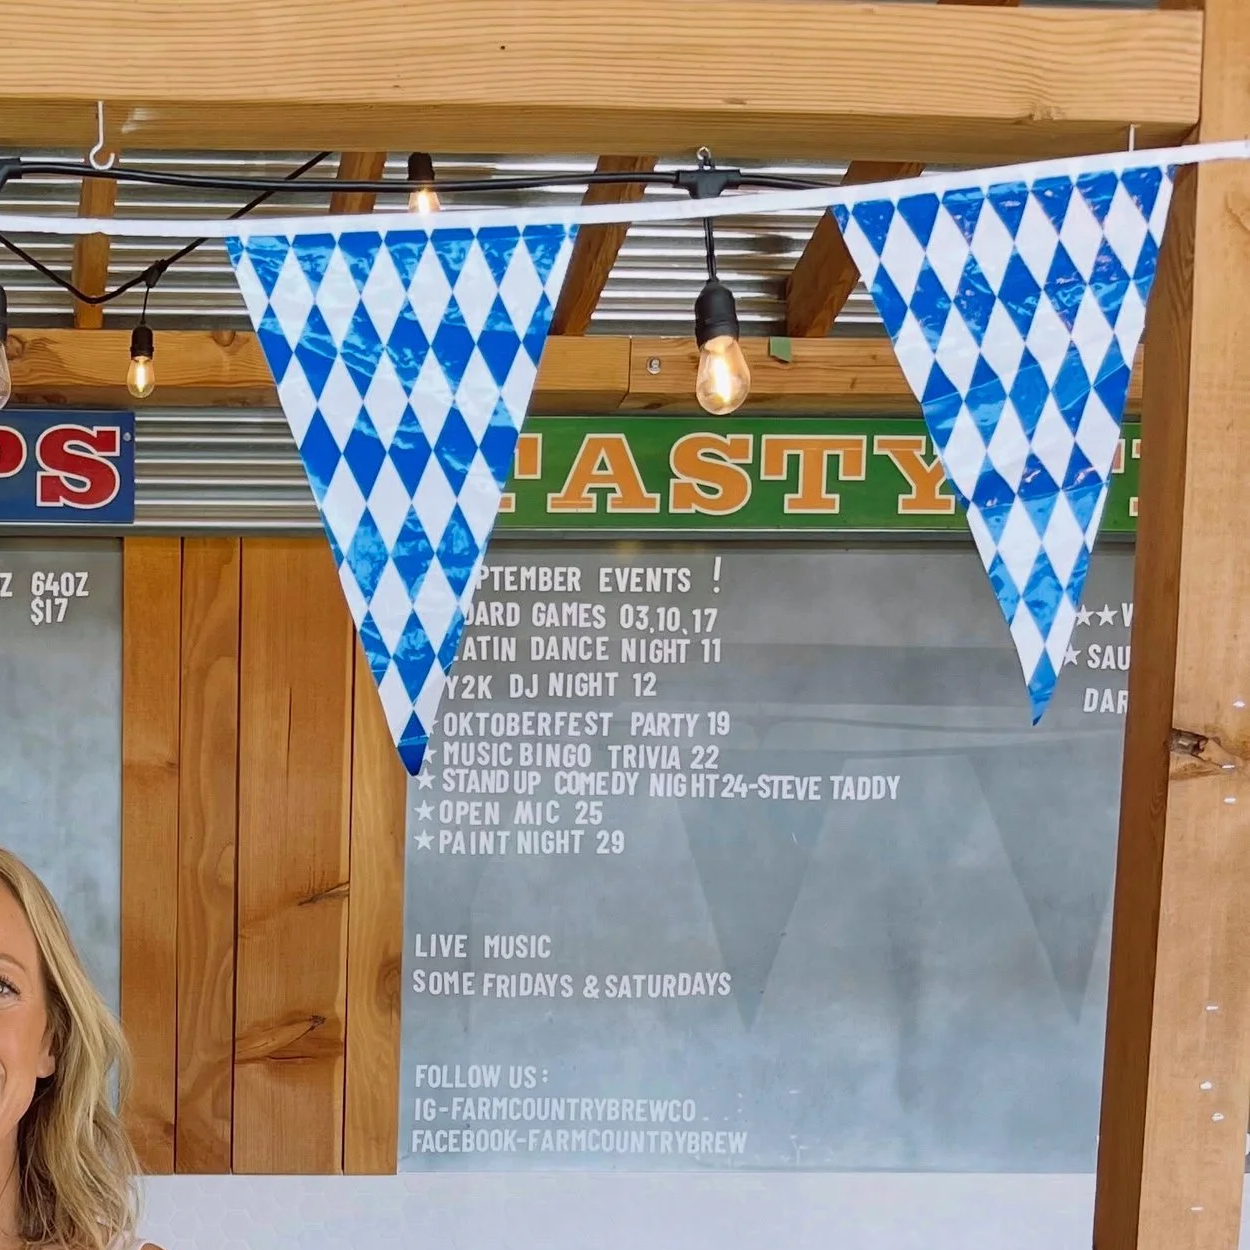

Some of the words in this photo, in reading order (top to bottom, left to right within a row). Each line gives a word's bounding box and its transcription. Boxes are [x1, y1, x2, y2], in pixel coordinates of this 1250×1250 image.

[31, 572, 89, 596] 64OZ
[476, 566, 581, 591] PTEMBER
[600, 567, 691, 592] EVENTS
[31, 598, 68, 623] $17
[532, 602, 606, 629] GAMES
[453, 635, 516, 661] ATIN
[531, 636, 609, 660] DANCE
[622, 638, 690, 663] NIGHT
[701, 638, 721, 662] 11
[446, 675, 492, 699] Y2K
[510, 674, 538, 698] DJ
[549, 672, 618, 698] NIGHT
[633, 672, 656, 696] 12
[444, 711, 613, 736] OKTOBERFEST
[631, 712, 700, 737] PARTY
[708, 711, 730, 735] 19
[444, 742, 512, 766] MUSIC
[520, 743, 591, 767] BINGO
[608, 745, 680, 769] TRIVIA
[691, 745, 719, 769] 22
[443, 768, 509, 793] STAND
[514, 771, 541, 794] UP
[555, 771, 639, 795] COMEDY
[830, 776, 900, 800] TADDY
[440, 800, 499, 825] OPEN
[514, 800, 559, 825] MIC
[575, 801, 602, 824] 25
[440, 830, 510, 855] PAINT
[518, 830, 584, 854] NIGHT
[597, 830, 624, 854] 29
[416, 934, 467, 957] LIVE
[485, 935, 551, 959] MUSIC
[413, 969, 475, 995] SOME
[483, 973, 573, 997] FRIDAYS
[583, 975, 599, 998] &
[605, 972, 731, 998] SATURDAYS
[416, 1065, 501, 1088] FOLLOW
[415, 1098, 695, 1121] IG-FARMCOUNTRYBREWCO
[412, 1130, 747, 1153] FACEBOOK-FARMCOUNTRYBREW
